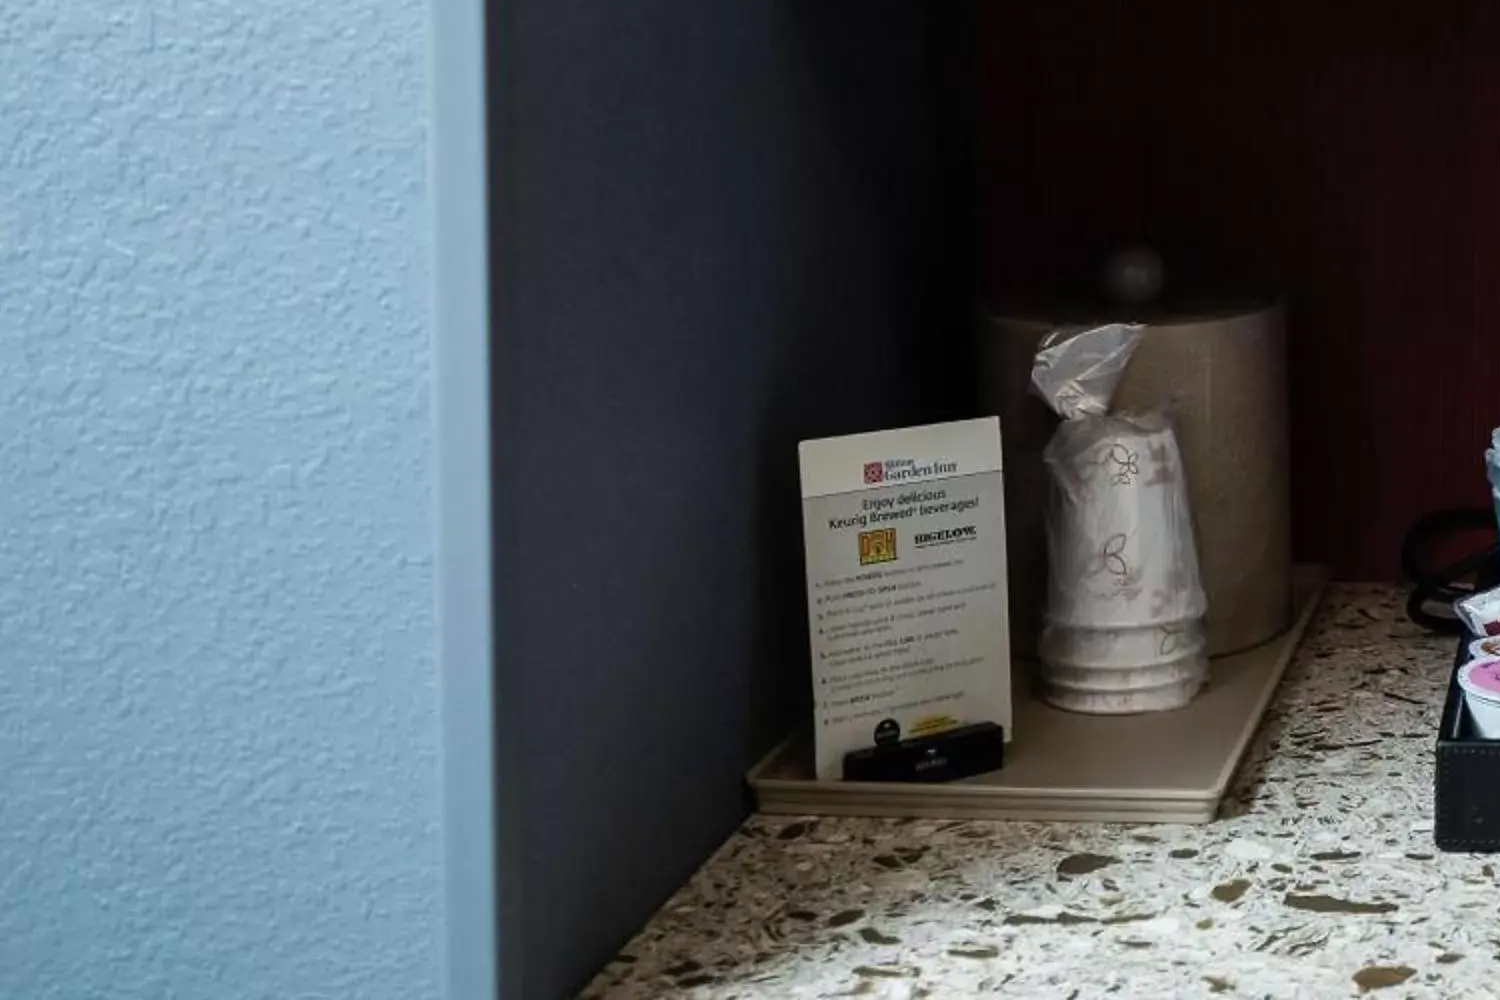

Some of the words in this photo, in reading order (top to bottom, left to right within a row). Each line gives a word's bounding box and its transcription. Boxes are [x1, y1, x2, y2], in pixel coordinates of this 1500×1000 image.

[862, 498, 895, 512] Enjoy
[897, 489, 947, 505] delicious
[828, 511, 867, 530] Keurig
